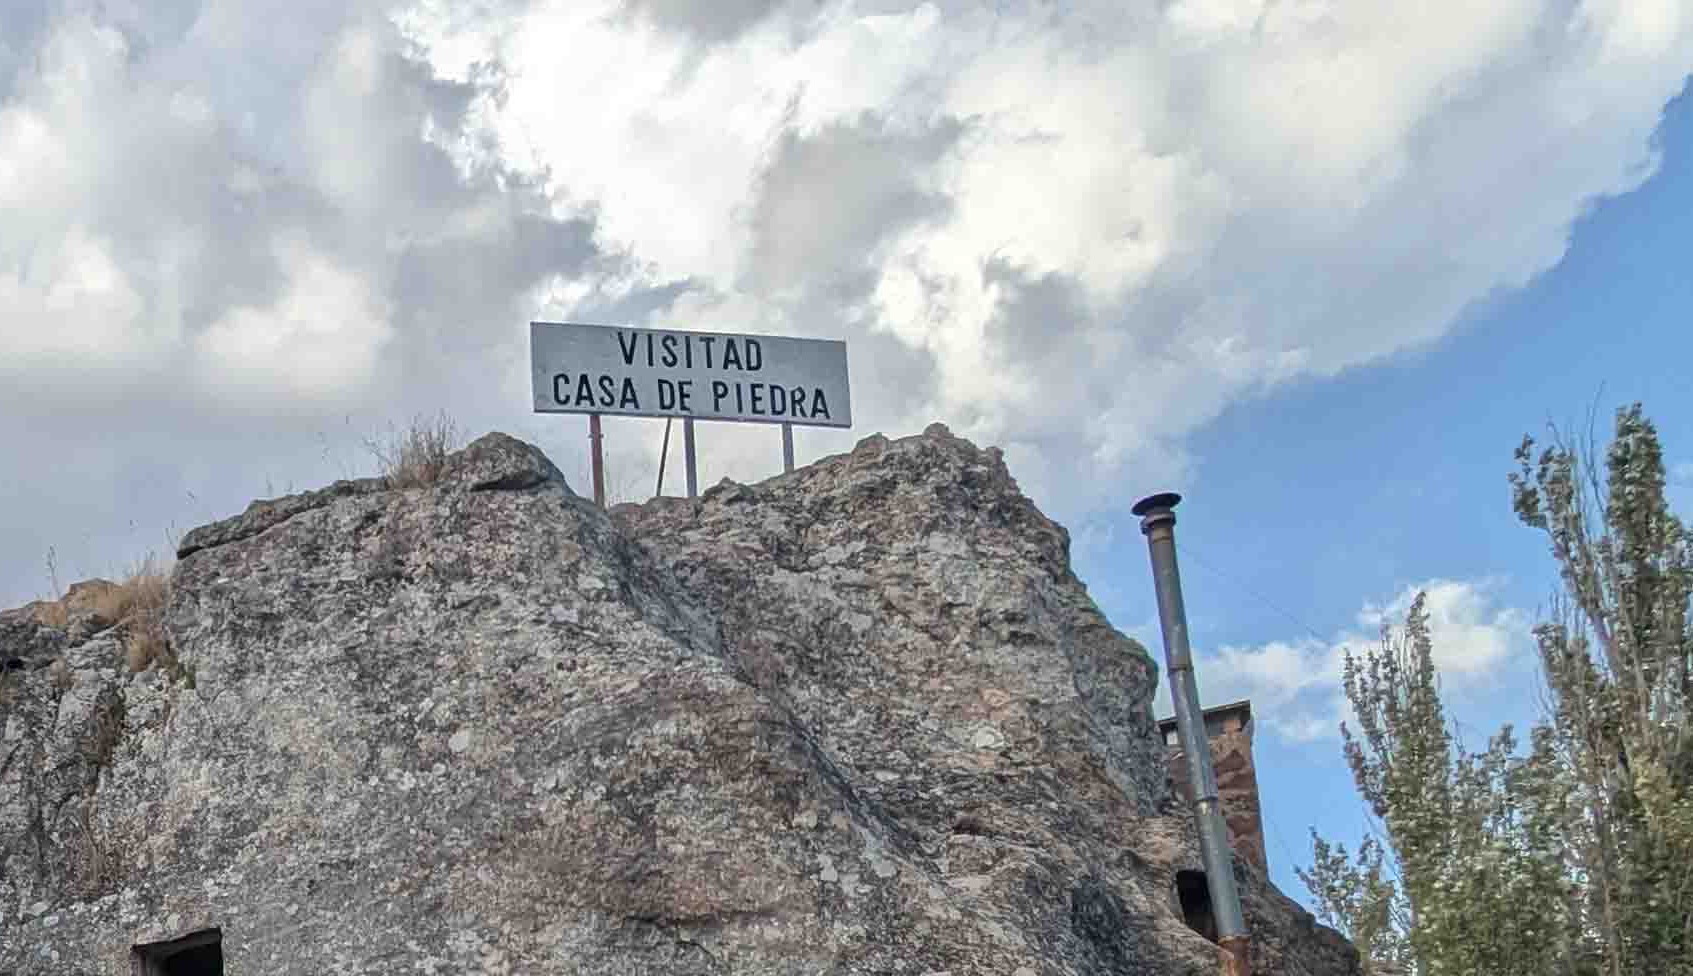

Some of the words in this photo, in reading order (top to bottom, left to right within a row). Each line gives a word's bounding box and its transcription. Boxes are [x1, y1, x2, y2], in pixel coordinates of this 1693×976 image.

[617, 331, 763, 371] VISITAD
[552, 373, 641, 410] CASA
[657, 379, 693, 412] DE
[712, 380, 831, 420] PIEDRA
